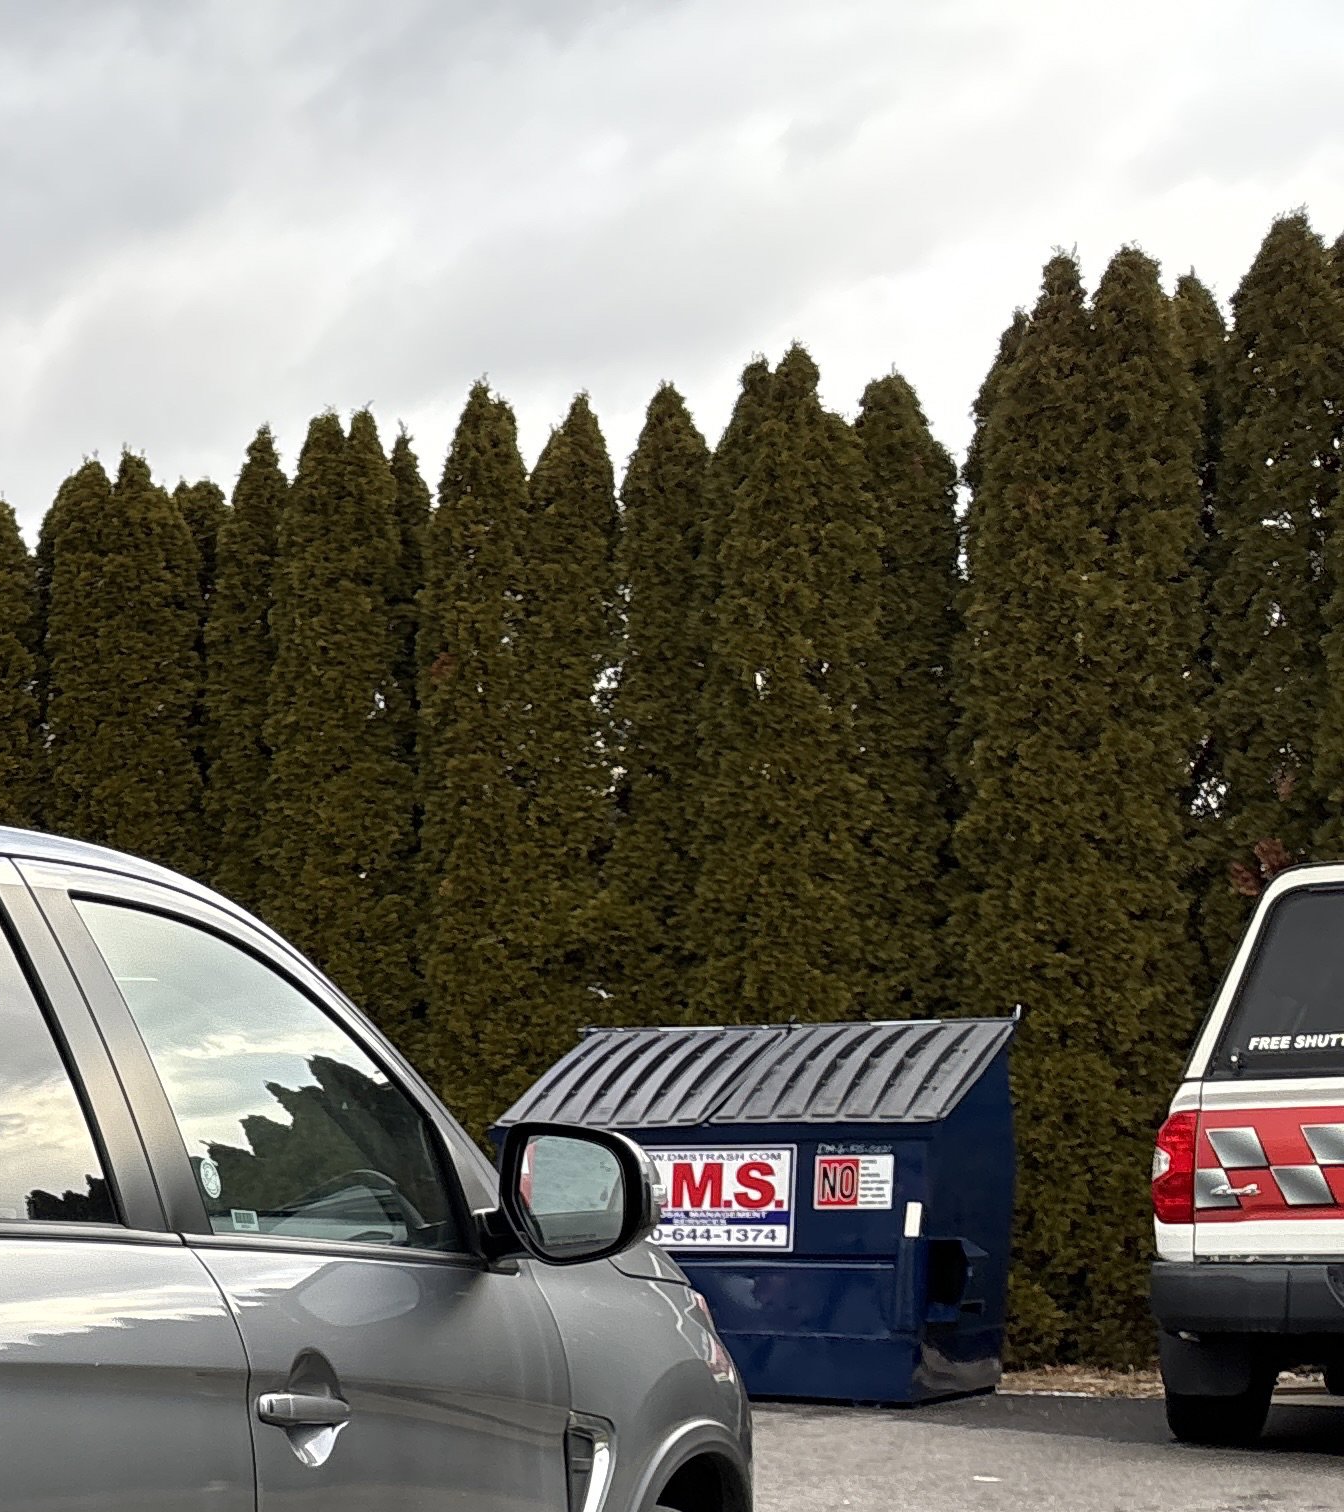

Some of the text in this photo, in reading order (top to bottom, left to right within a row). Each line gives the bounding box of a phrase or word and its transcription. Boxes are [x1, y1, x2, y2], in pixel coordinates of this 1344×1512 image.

[1248, 1035, 1292, 1050] FREE
[820, 1163, 857, 1202] NO
[650, 1228, 777, 1243] 0-644-1374
